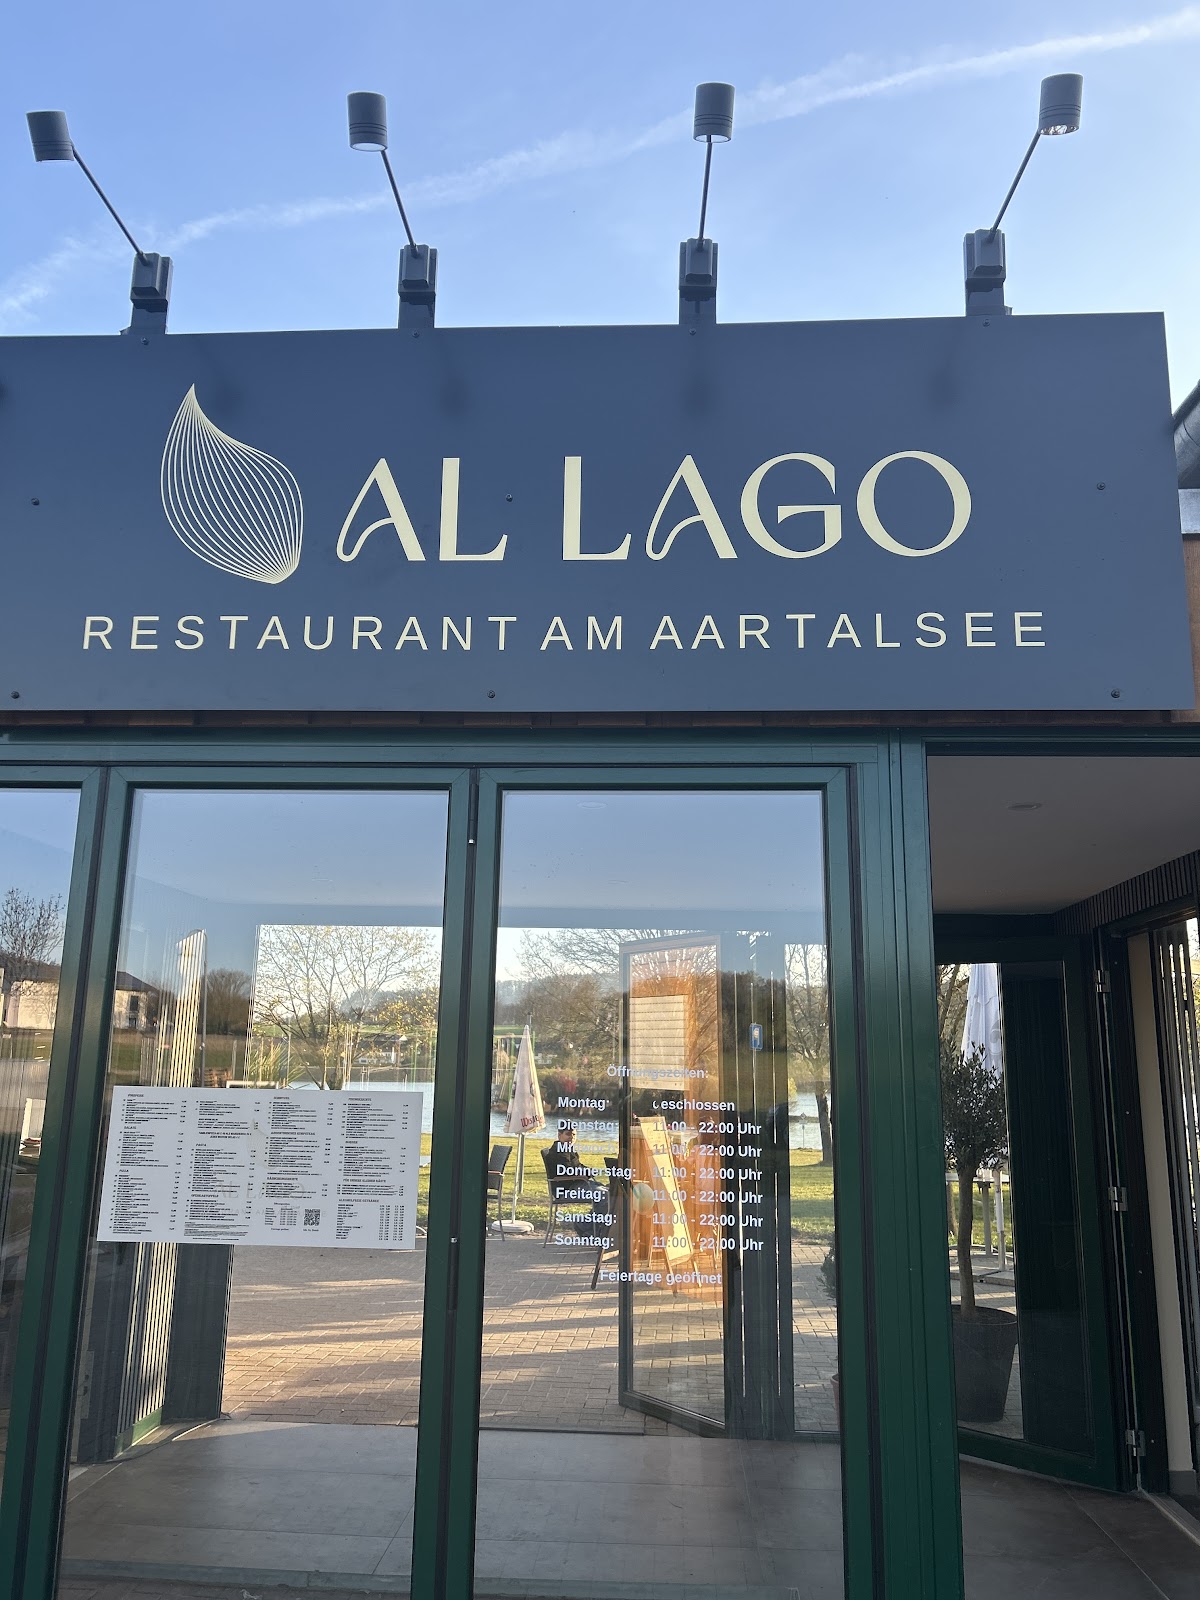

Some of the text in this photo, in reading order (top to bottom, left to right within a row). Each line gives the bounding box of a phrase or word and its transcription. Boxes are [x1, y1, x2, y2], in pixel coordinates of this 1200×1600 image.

[336, 451, 972, 562] AL LAGO
[83, 611, 1046, 651] RESTAURANT AM AARTALSEE
[558, 1097, 609, 1111] Montag:
[557, 1119, 619, 1133] Dienstag:
[652, 1121, 687, 1132] 11:00
[698, 1122, 734, 1134] 22:00
[738, 1123, 762, 1134] Uhr
[652, 1143, 687, 1155] 11:00
[699, 1144, 735, 1157] 22:00
[738, 1145, 762, 1157] Uhr
[556, 1164, 636, 1180] Donnerstag:
[652, 1166, 687, 1178] 11:00
[699, 1167, 735, 1179] 22:00
[738, 1168, 763, 1181] Uhr
[556, 1187, 606, 1202] Freitag:
[653, 1189, 687, 1201] 11:00
[699, 1190, 735, 1203] 22:00
[738, 1191, 763, 1204] Uhr
[555, 1210, 617, 1226] Samstag:
[652, 1213, 688, 1225] 11:00
[699, 1214, 736, 1226] 22:00
[739, 1214, 764, 1227] Uhr
[555, 1233, 614, 1249] Sonntag:
[652, 1236, 687, 1248] 11:00
[699, 1237, 736, 1250] 22:00
[739, 1238, 764, 1251] Uhr
[599, 1269, 723, 1286] Feiertage geöffnet
